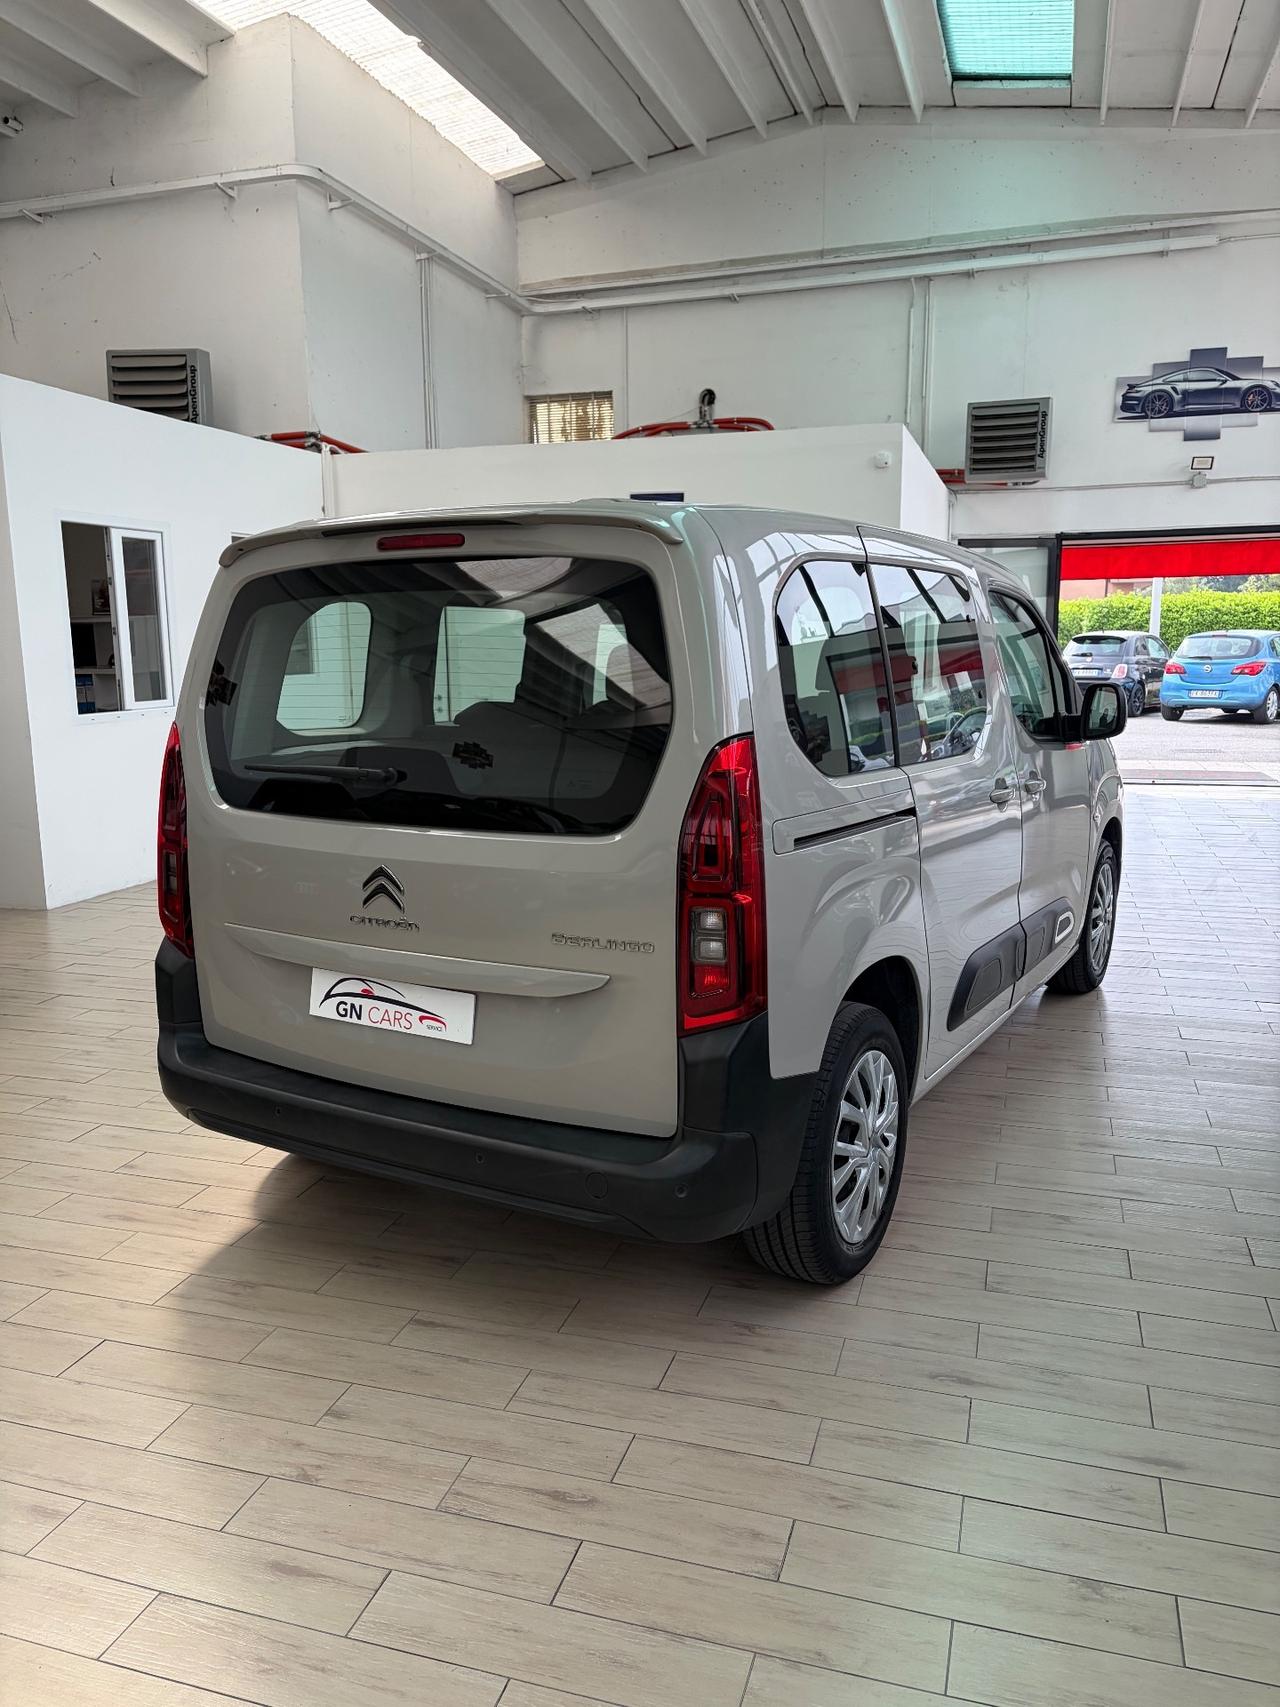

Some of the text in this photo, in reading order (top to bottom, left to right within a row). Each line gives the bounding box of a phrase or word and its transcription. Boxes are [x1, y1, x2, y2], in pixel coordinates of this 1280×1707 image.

[189, 365, 199, 424] ApenGroup
[1038, 411, 1048, 458] ApenGroup
[551, 932, 655, 953] BERLINGO
[335, 1000, 413, 1030] GN CARS
[426, 1023, 443, 1032] SERVICE
